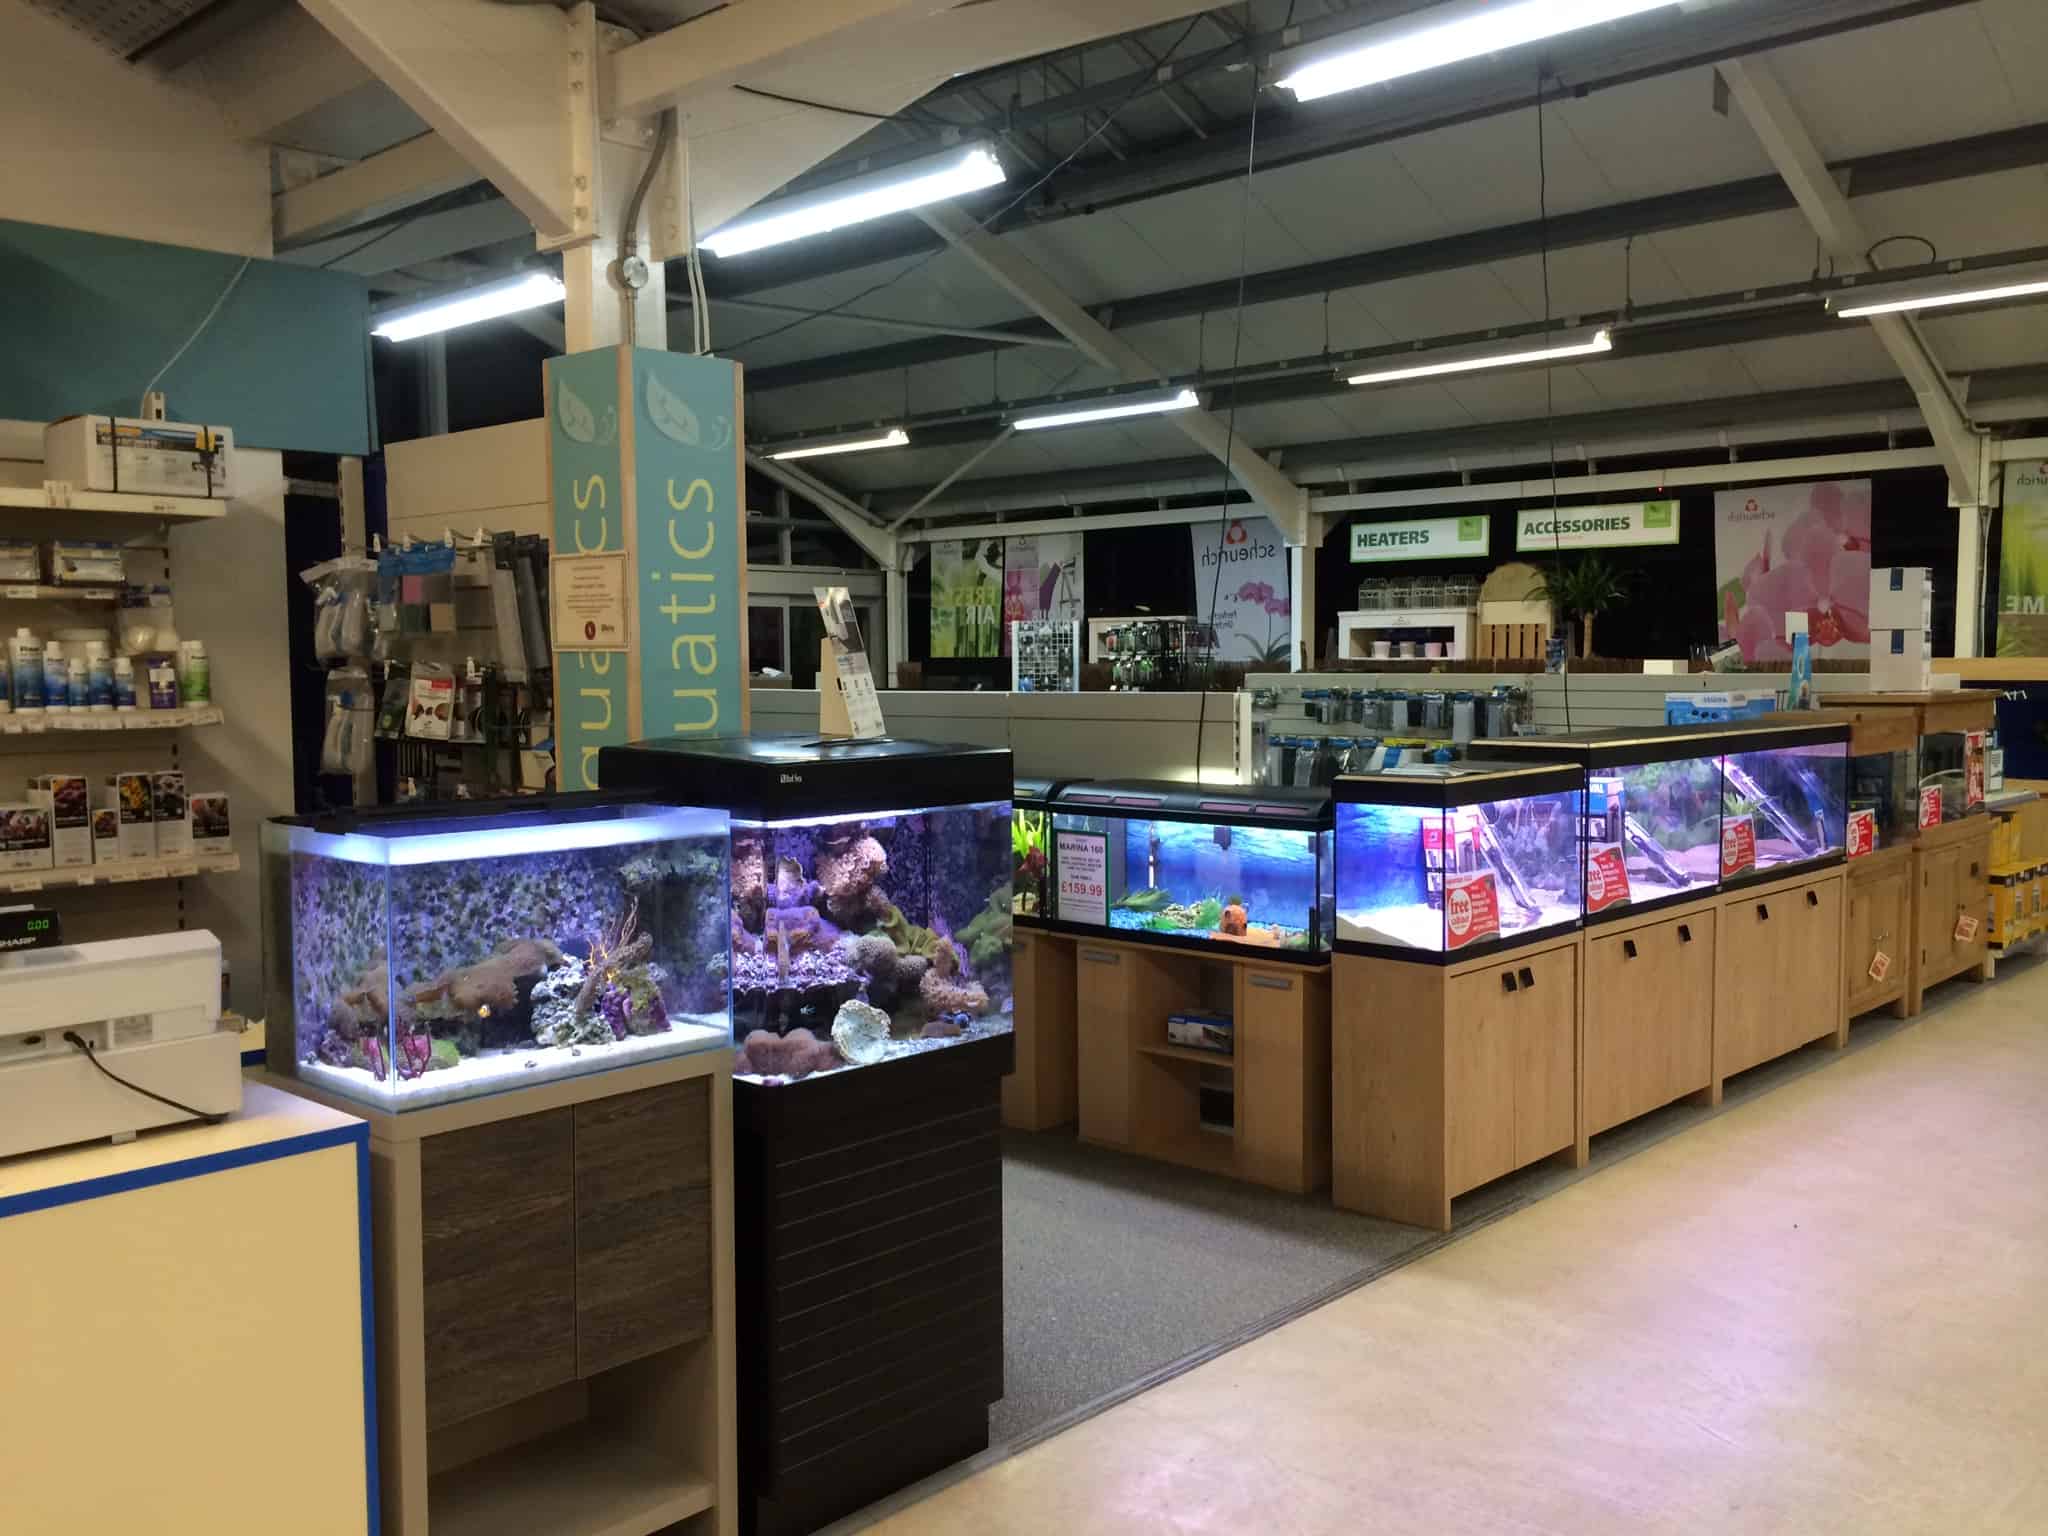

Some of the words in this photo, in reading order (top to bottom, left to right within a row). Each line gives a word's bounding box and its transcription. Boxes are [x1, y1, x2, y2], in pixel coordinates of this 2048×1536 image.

[1524, 517, 1630, 535] ACCESSORIES
[1357, 530, 1430, 548] HEATERS
[650, 478, 719, 735] uatics
